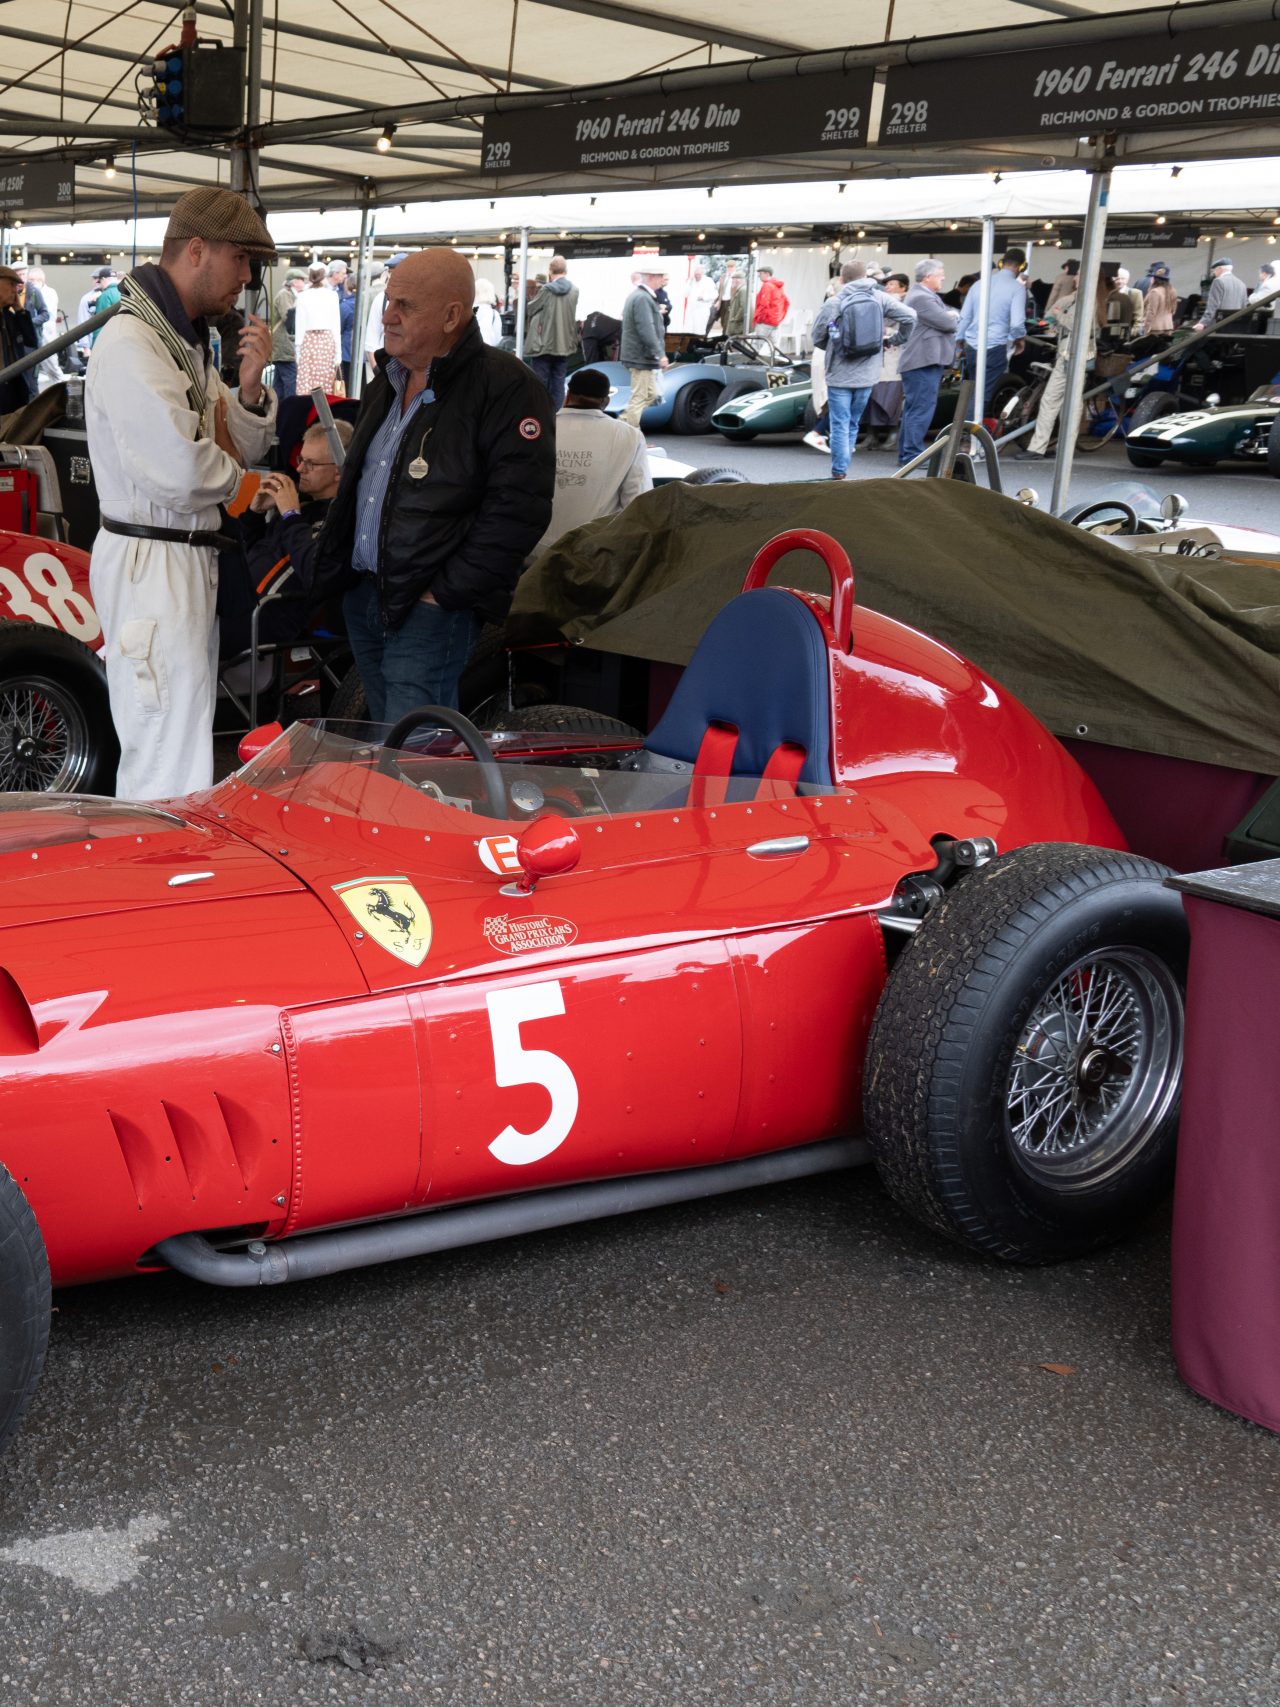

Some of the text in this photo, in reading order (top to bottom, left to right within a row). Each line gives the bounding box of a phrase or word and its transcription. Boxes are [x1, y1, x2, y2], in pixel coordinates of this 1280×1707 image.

[1033, 65, 1092, 97] 1960
[1096, 54, 1181, 91] Ferrari
[1183, 48, 1240, 83] 246
[575, 103, 741, 142] 1960 Ferrari 246 Dino
[824, 107, 861, 132] 299
[889, 100, 929, 125] 298
[1040, 107, 1118, 126] RICHMOND
[1121, 106, 1132, 119] &
[1136, 100, 1204, 118] GORDON
[821, 129, 860, 141] SHELTER
[886, 123, 927, 135] SHELTER
[486, 142, 511, 161] 299
[581, 141, 730, 164] RICHMOND & GORDON TROPHIES
[485, 159, 511, 169] SHELTER
[556, 449, 593, 459] AWKER
[495, 923, 573, 945] GRAND PRIX CARS
[508, 917, 552, 933] HISTORIC
[510, 934, 567, 953] ASSOCIATION
[485, 980, 579, 1165] 5
